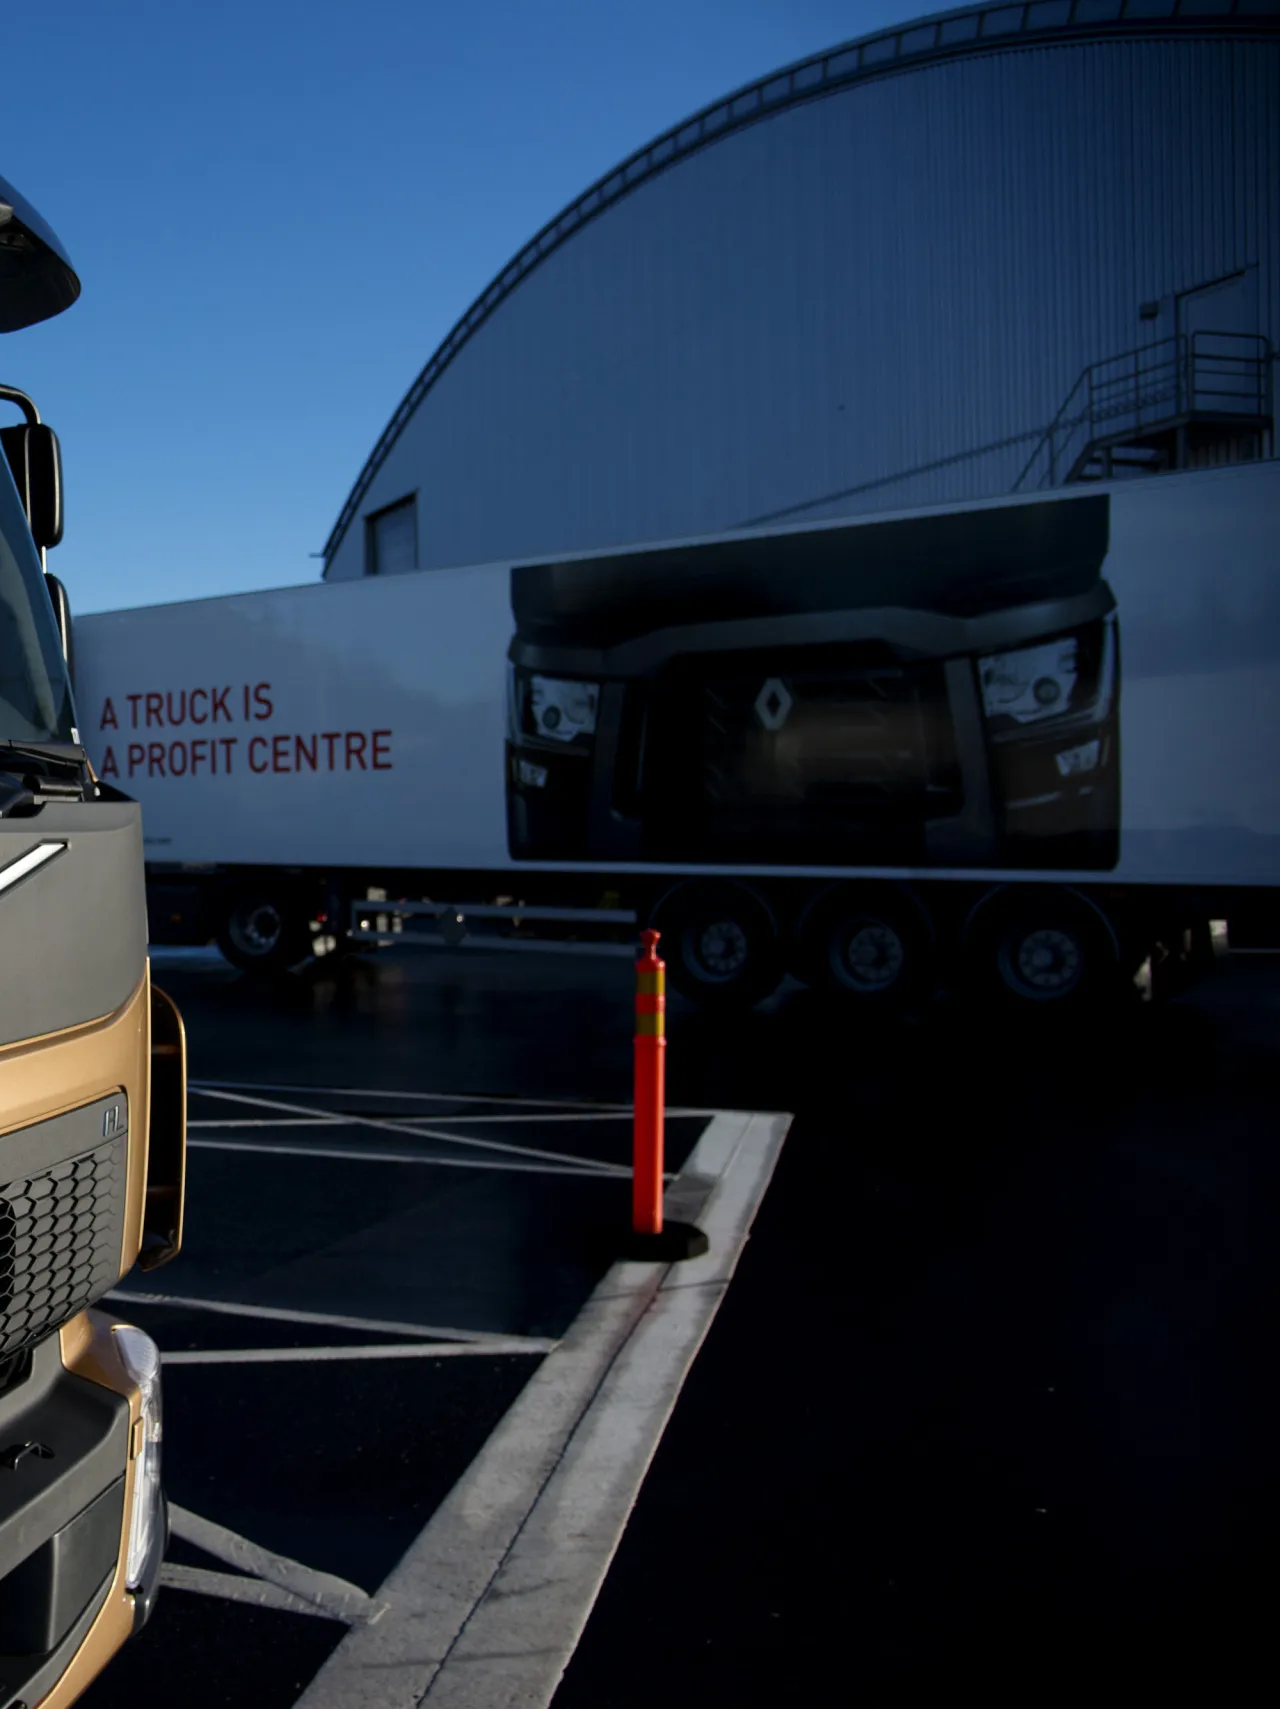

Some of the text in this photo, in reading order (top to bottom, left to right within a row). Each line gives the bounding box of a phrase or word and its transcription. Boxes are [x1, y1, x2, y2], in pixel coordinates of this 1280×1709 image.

[100, 682, 273, 730] A TRUCK IS
[101, 730, 393, 778] A PROFIT CENTRE
